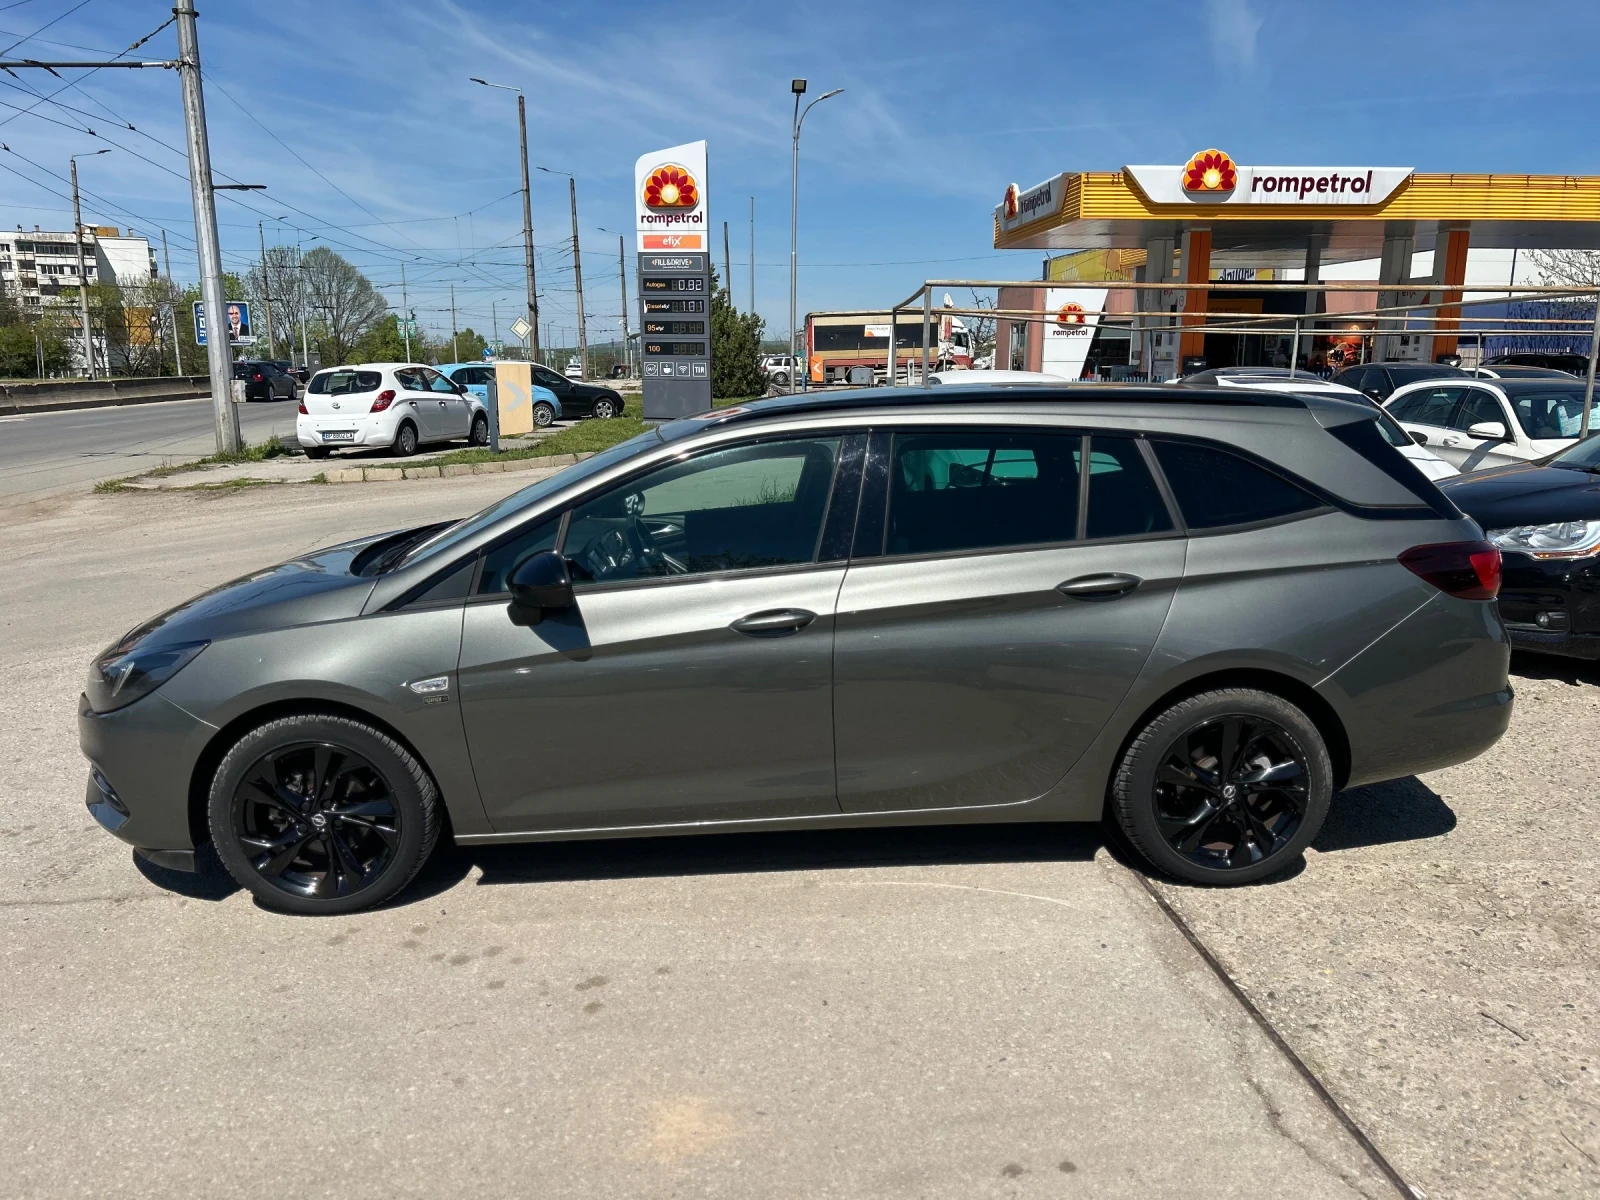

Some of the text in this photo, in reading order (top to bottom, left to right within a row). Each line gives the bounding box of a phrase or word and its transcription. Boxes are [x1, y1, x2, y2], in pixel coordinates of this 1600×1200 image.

[1251, 170, 1373, 200] rompetrol
[1020, 181, 1052, 216] rompetrol
[641, 211, 703, 227] rompetrol
[662, 236, 682, 247] efix
[1052, 328, 1088, 338] rompetrol
[694, 366, 705, 374] TIR
